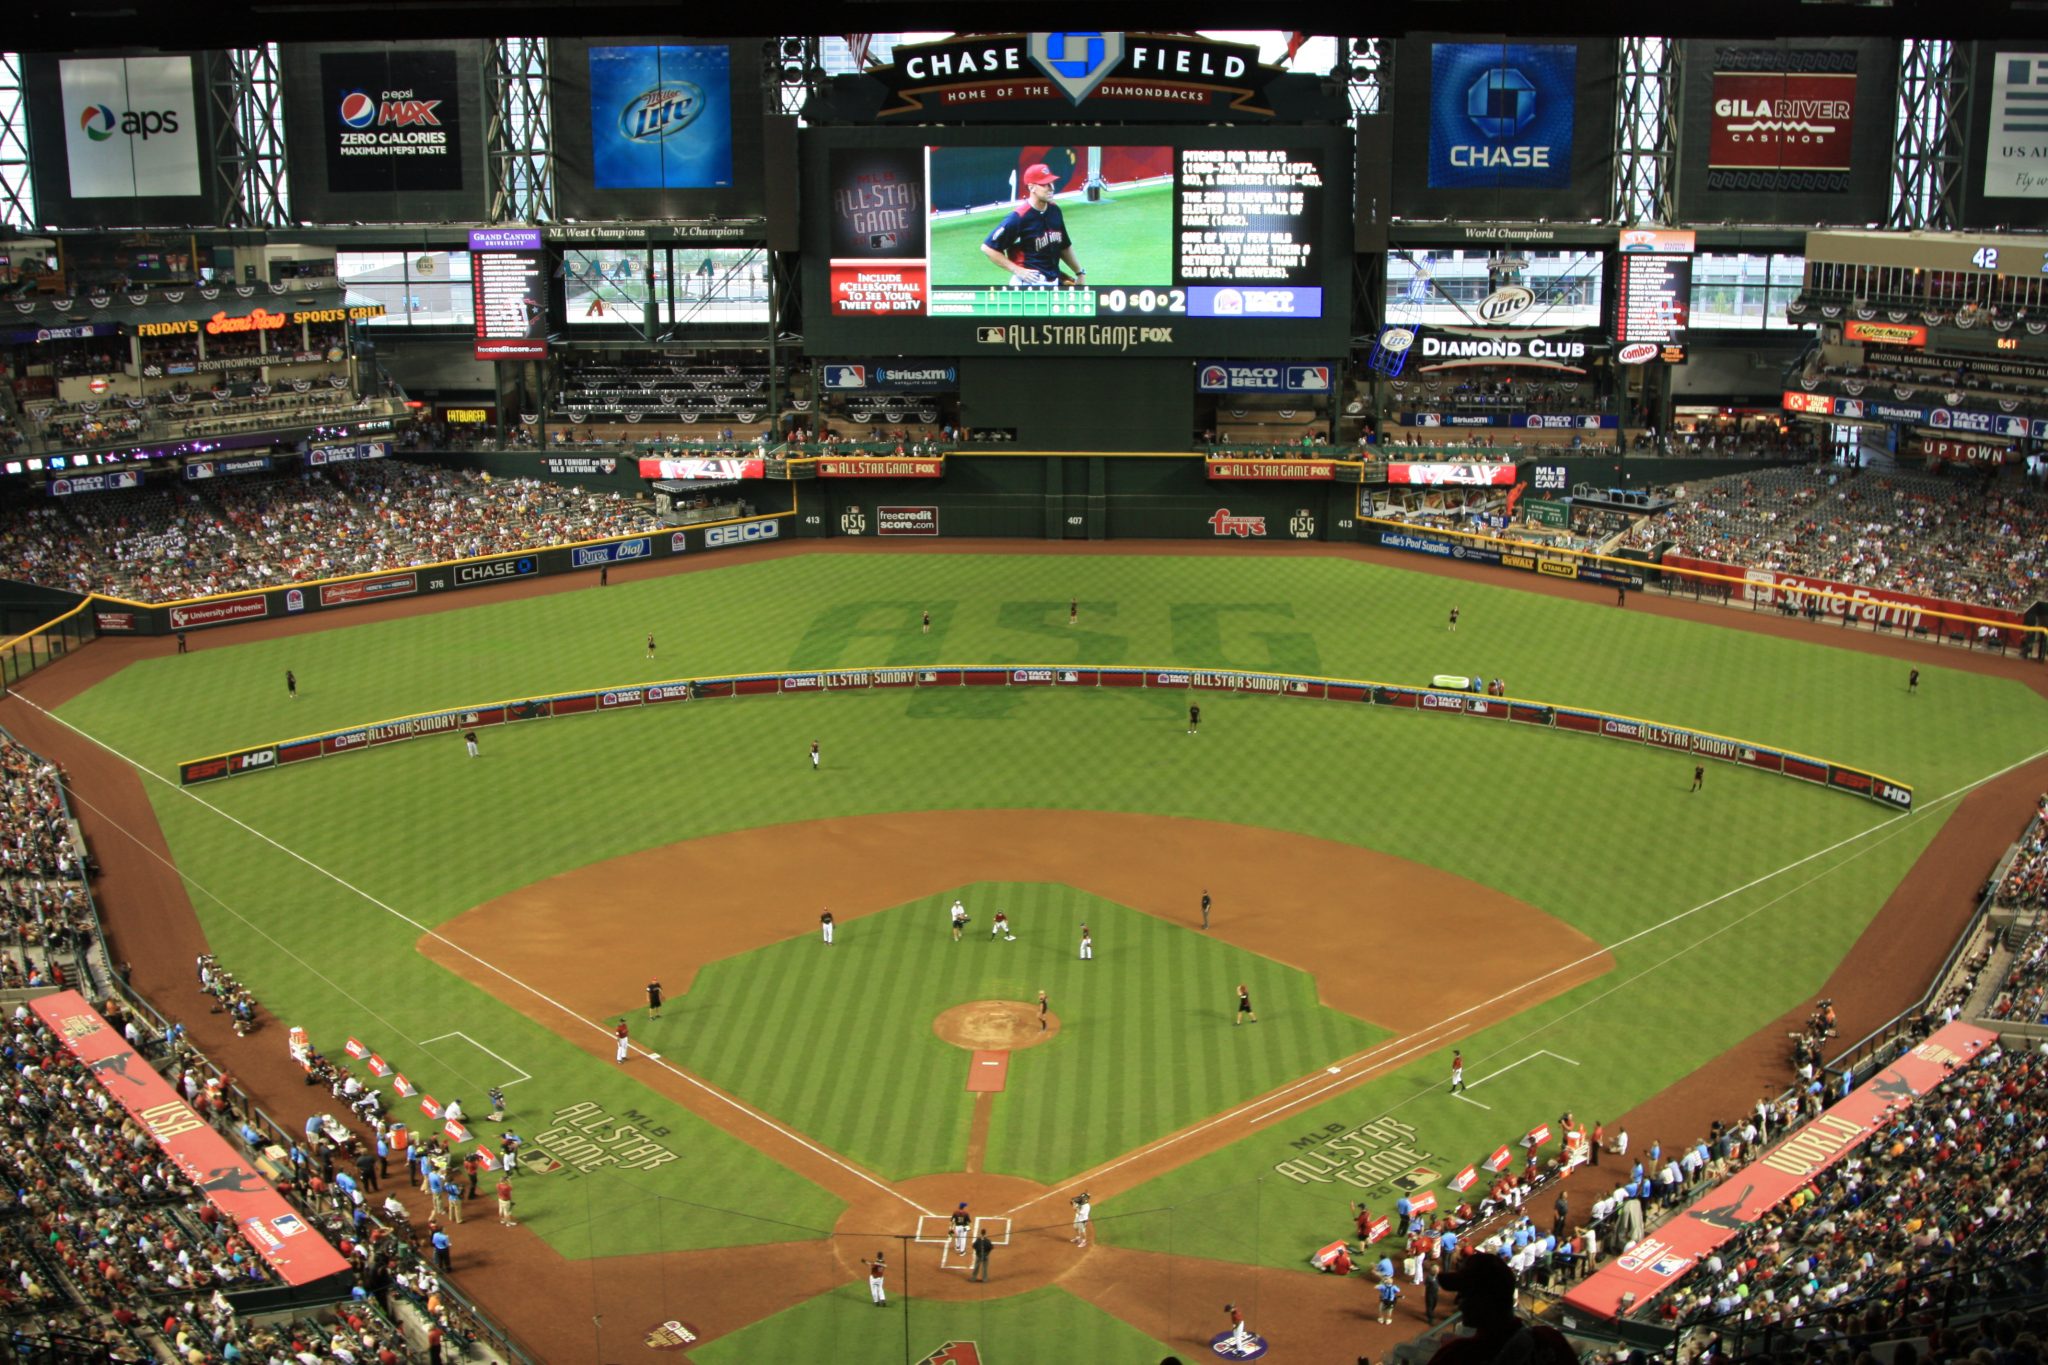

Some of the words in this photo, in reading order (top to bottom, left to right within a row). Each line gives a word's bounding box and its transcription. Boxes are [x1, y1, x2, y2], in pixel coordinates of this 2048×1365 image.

[906, 47, 1020, 79] CHASE
[1133, 47, 1246, 78] FIELD
[382, 89, 414, 100] pepsi
[642, 88, 681, 108] Miller
[947, 89, 987, 102] HOME
[996, 87, 1014, 97] OF
[1024, 86, 1050, 96] THE
[1101, 86, 1204, 101] DIAMONDBACKS
[377, 99, 443, 127] MAX
[1715, 99, 1773, 118] GILA
[1773, 100, 1850, 119] RIVER
[634, 97, 692, 138] Lite
[121, 109, 178, 141] aps
[340, 133, 377, 145] ZERO
[379, 132, 447, 144] CALORIES
[1732, 134, 1824, 143] CASINOS
[340, 146, 388, 155] MAXIMUM
[390, 146, 416, 155] PEPSI
[417, 146, 447, 154] TASTE
[1449, 145, 1551, 168] CHASE
[1182, 203, 1225, 215] ELECTED
[1226, 203, 1240, 215] TO
[1241, 203, 1261, 215] THE
[1263, 204, 1288, 215] HALL
[1289, 204, 1304, 215] OF
[853, 207, 910, 234] GAME
[473, 232, 502, 241] GRAND
[503, 232, 536, 241] CANYON
[549, 228, 563, 237] NL
[566, 228, 589, 237] West
[591, 227, 645, 238] Champions
[674, 227, 688, 236] NL
[690, 226, 745, 237] Champions
[1465, 228, 1496, 239] World
[1498, 228, 1554, 241] Champions
[1972, 247, 1999, 269] 42
[857, 272, 902, 283] INCLUDE
[839, 282, 920, 292] #CELEBSOFTBALL
[848, 291, 863, 300] TO
[865, 291, 882, 300] SEE
[884, 291, 913, 301] YOUR
[839, 300, 873, 310] TWEET
[874, 301, 890, 310] ON
[1489, 296, 1526, 319] Lite
[138, 320, 199, 337] FRIDAY'S
[293, 308, 346, 324] SPORTS
[350, 305, 387, 319] GRILL
[1009, 324, 1040, 351] ALL
[1042, 324, 1086, 345] STAR
[1090, 324, 1137, 351] GAME
[1140, 327, 1173, 343] FOX
[1386, 336, 1409, 347] Lite
[477, 345, 543, 353] freecreditscore.com
[1422, 338, 1521, 357] DIAMOND
[1528, 339, 1585, 358] CLUB
[1621, 344, 1655, 360] Combos
[198, 355, 293, 371] FRONTROWPHOENIX.com
[1870, 352, 1902, 362] ARIZONA
[1903, 355, 1941, 367] BASEBALL
[1972, 363, 2000, 373] DINING
[2001, 366, 2023, 374] OPEN
[2025, 367, 2035, 375] TO
[886, 368, 947, 381] SiriusXM
[1228, 367, 1279, 378] TACO
[1230, 377, 1279, 388] BELL
[447, 409, 487, 423] FATBURGER
[1452, 415, 1488, 425] SiriusXM
[1878, 408, 1922, 419] SiriusXM
[1951, 411, 1990, 423] TACO
[1953, 420, 1990, 432] BELL
[325, 448, 356, 456] TACO
[326, 454, 357, 462] BELL
[1924, 442, 2003, 462] UPTOWN
[225, 459, 264, 471] SiriusXM
[548, 458, 562, 466] MLB
[564, 458, 591, 466] TONIGHT
[839, 462, 857, 474] ALL
[858, 462, 884, 475] STAR
[886, 462, 914, 476] GAME
[916, 463, 936, 474] FOX
[1233, 464, 1251, 477] ALL
[1253, 464, 1279, 477] STAR
[1281, 464, 1309, 478] GAME
[1311, 466, 1331, 476] FOX
[1535, 466, 1566, 475] MLB
[71, 476, 104, 485] TACO
[73, 482, 105, 492] BELL
[1535, 481, 1565, 489] CAVE
[805, 516, 820, 525] 413
[880, 510, 932, 520] freecredit
[1067, 516, 1082, 525] 407
[841, 514, 866, 532] ASG
[880, 521, 935, 529] score.com
[1208, 508, 1267, 538] fry's
[1290, 517, 1315, 535] ASG
[1338, 520, 1353, 528] 413
[707, 520, 778, 545] GEICO
[619, 543, 641, 557] Dial
[1381, 533, 1404, 547] Leslie's
[1405, 537, 1419, 548] Pool
[1419, 539, 1450, 555] Supplies
[579, 547, 608, 565] Purex
[1502, 554, 1534, 569] DEWALT
[461, 560, 516, 581] CHASE
[1542, 562, 1572, 574] STANLEY
[430, 579, 444, 590] 376
[1777, 578, 1837, 614] State
[1850, 588, 1922, 628] Farm
[190, 607, 225, 620] University
[225, 606, 233, 614] of
[234, 602, 262, 613] Phoenix
[817, 673, 840, 688] ALL
[840, 672, 868, 687] STAR
[874, 671, 914, 684] SUNDAY
[1193, 673, 1213, 687] ALL
[1215, 673, 1245, 689] STAR
[1246, 676, 1290, 692] SUNDAY
[617, 690, 641, 698] TACO
[662, 685, 686, 693] TACO
[368, 725, 387, 742] ALL
[387, 721, 412, 740] STAR
[413, 714, 456, 733] SUNDAY
[1638, 725, 1660, 742] ALL
[1661, 729, 1689, 748] STAR
[1693, 735, 1736, 757] SUNDAY
[187, 756, 242, 780] ESPN
[242, 750, 274, 768] HD
[1834, 771, 1884, 796] ESPN
[1883, 786, 1911, 804] HD
[140, 1100, 206, 1138] USA
[622, 1109, 671, 1137] MLB
[552, 1101, 615, 1135] ALL
[594, 1125, 681, 1171] STAR
[1289, 1122, 1347, 1150] MLB
[533, 1126, 622, 1174] GAME
[1274, 1151, 1350, 1184] ALL
[1323, 1116, 1418, 1160] STAR
[1761, 1114, 1865, 1177] WORLD
[1334, 1142, 1433, 1188] GAME
